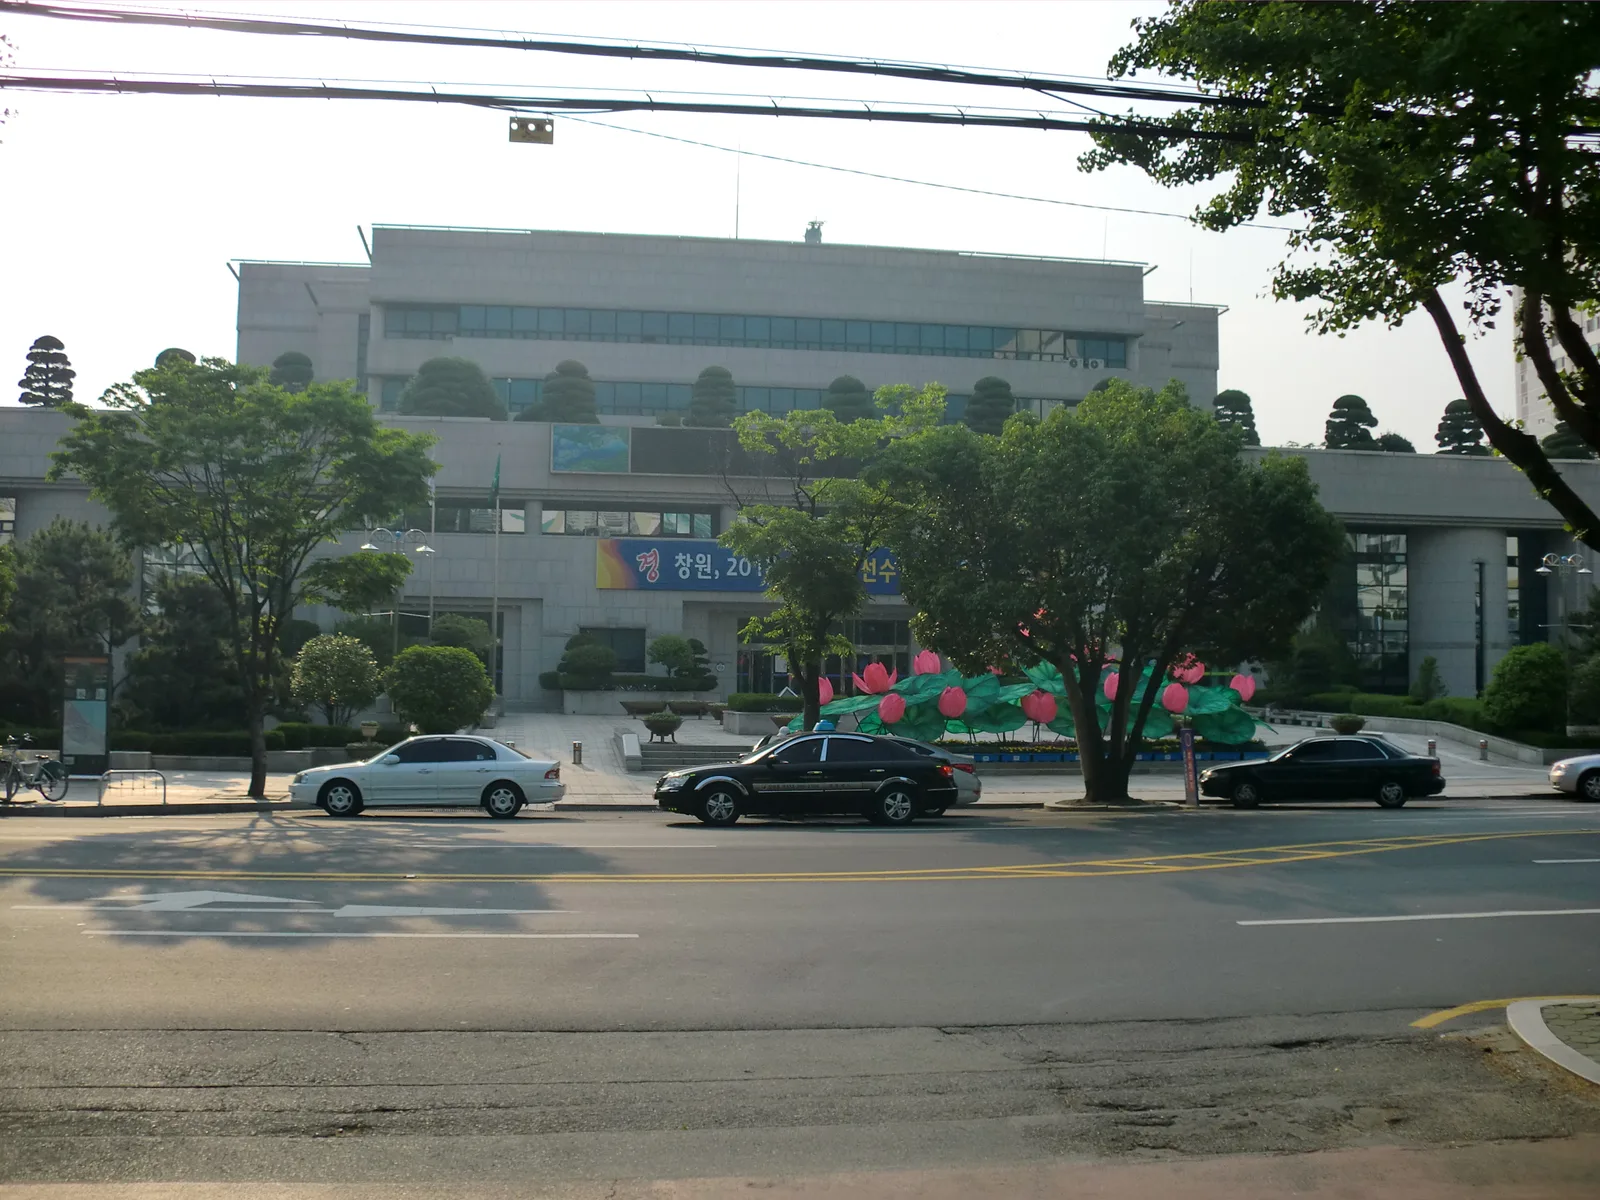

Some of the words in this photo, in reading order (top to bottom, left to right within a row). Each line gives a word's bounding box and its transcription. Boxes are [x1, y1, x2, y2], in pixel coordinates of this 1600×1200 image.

[636, 548, 660, 583] 경
[674, 552, 720, 580] 창원,
[726, 557, 777, 577] 201
